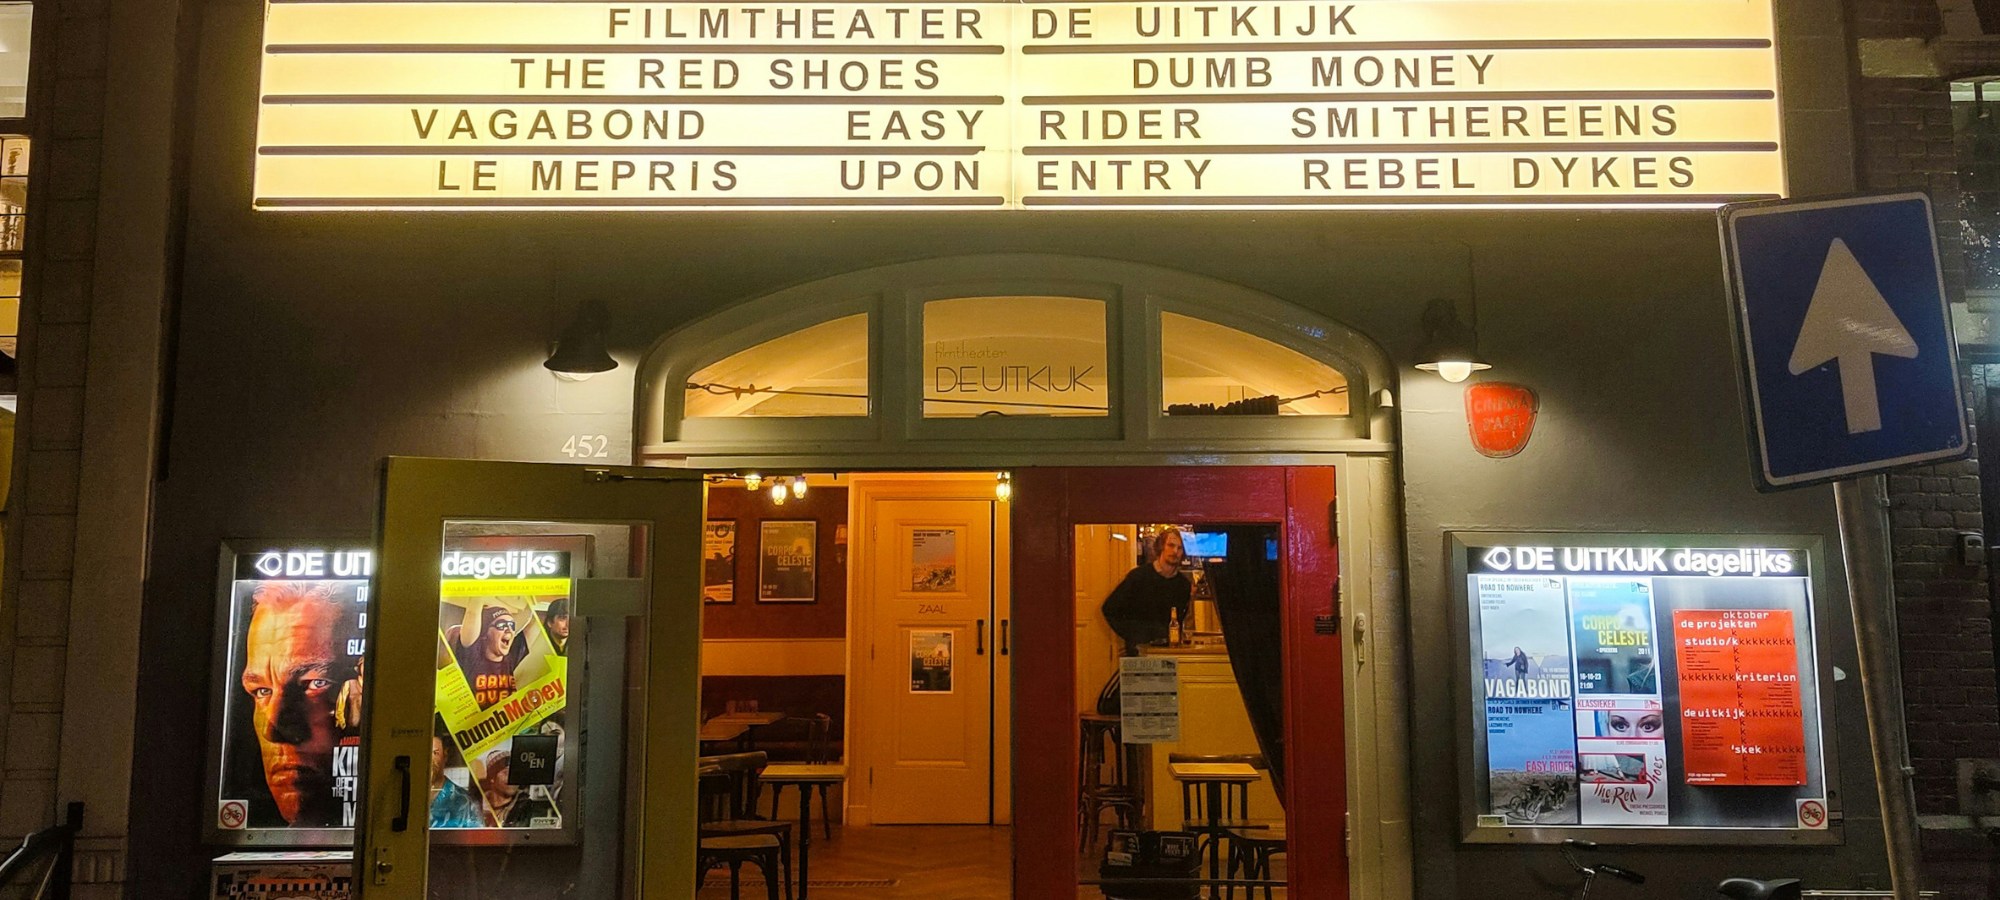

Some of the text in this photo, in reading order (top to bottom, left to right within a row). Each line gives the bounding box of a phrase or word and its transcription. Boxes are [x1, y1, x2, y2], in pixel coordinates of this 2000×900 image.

[610, 6, 1356, 38] FILMTHEATER DE UITKIJK
[511, 55, 1493, 91] THE RED SHOES DUMB MONEY
[412, 105, 1676, 140] VAGABOND EASY RIDER SMITHEREENS
[439, 157, 1693, 190] LE MEPRIS UPON ENTRY REBEL DYKES
[935, 341, 1007, 362] filmtheater
[936, 366, 1094, 392] DE UITKIJK
[561, 434, 608, 458] 452
[286, 552, 324, 576] DE
[441, 550, 556, 579] dagelijks
[777, 555, 812, 566] CELESTE
[1516, 547, 1792, 577] DE UITKIJK dagelijks
[1506, 584, 1534, 592] NOWHERE
[918, 604, 947, 614] ZAAL
[1723, 611, 1770, 619] oktober
[1680, 619, 1757, 630] de projekten
[1598, 630, 1650, 646] CELESTE
[475, 674, 517, 690] GAME
[1735, 672, 1796, 682] kriterion
[1484, 678, 1572, 698] VAGABOND
[1487, 706, 1543, 714] ROAD TO NOWHERE
[1577, 700, 1616, 708] KLASSIEKER
[1683, 708, 1696, 717] de
[1697, 708, 1745, 719] uitkijk
[1526, 761, 1574, 772] EASY RIDER
[336, 777, 345, 787] OF
[331, 787, 344, 798] THE
[1593, 776, 1611, 798] The
[1612, 786, 1637, 813] Red
